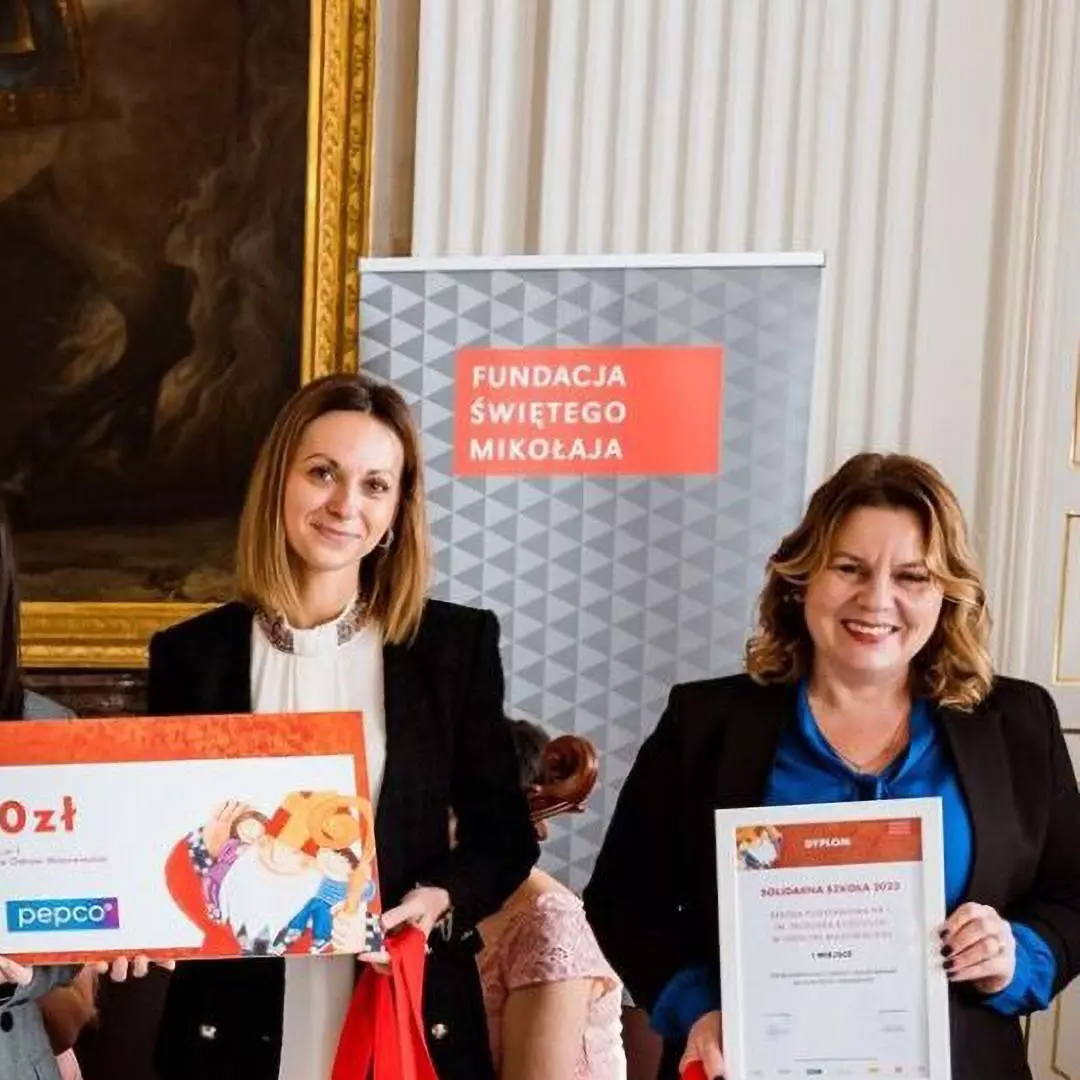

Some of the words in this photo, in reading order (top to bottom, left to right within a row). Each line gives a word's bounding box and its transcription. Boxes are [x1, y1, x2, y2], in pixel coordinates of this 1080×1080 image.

[472, 365, 626, 387] FUNDACJA
[470, 396, 626, 429] ŚWIĘTEGO
[470, 438, 623, 460] MIKOŁAJA
[803, 837, 852, 849] DYPLOM
[760, 884, 824, 898] SOLIDARNA
[19, 904, 105, 928] pepco
